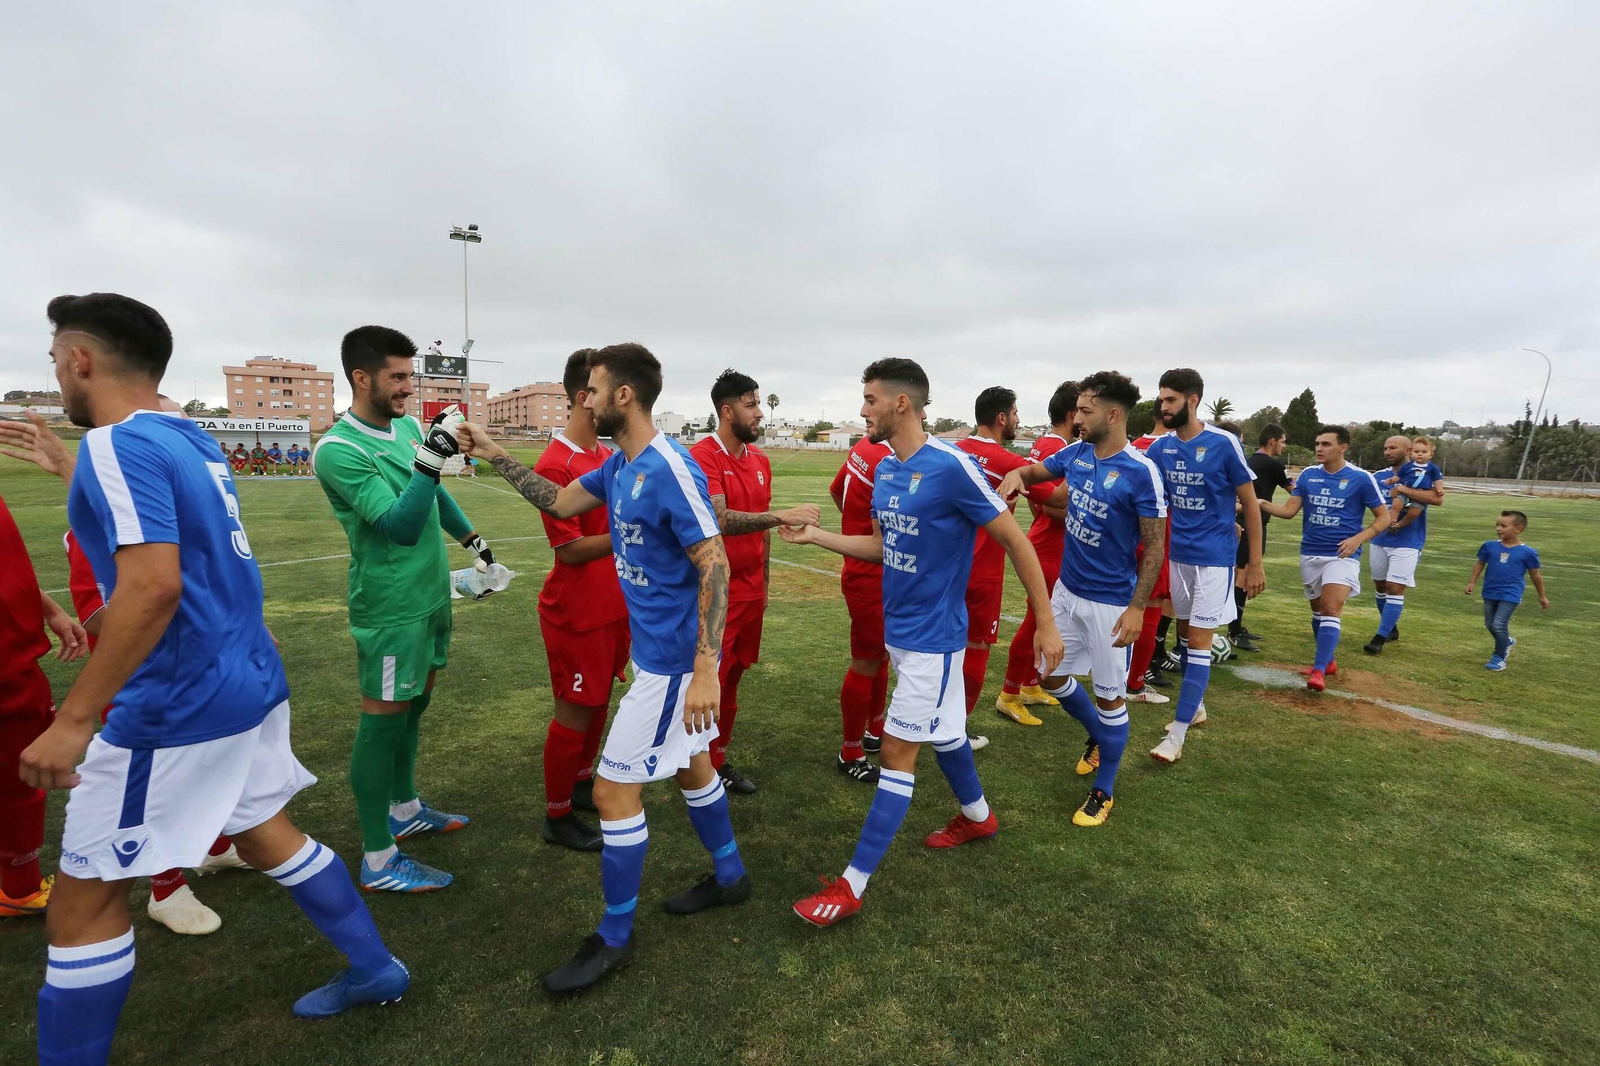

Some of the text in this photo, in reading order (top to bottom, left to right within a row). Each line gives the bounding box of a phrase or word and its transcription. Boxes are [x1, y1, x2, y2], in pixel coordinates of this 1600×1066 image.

[222, 421, 235, 430] Ya
[255, 422, 265, 430] El
[268, 422, 304, 431] Puerto
[1176, 461, 1187, 470] EL
[1083, 479, 1094, 493] EL
[1176, 486, 1187, 495] DE
[887, 495, 900, 509] EL
[1171, 494, 1206, 511] EREZ
[205, 461, 252, 560] 5
[1076, 510, 1086, 523] E
[886, 531, 897, 546] DE
[991, 620, 997, 635] 3
[573, 673, 583, 692] 2
[1095, 683, 1118, 692] macron
[891, 717, 922, 731] macron
